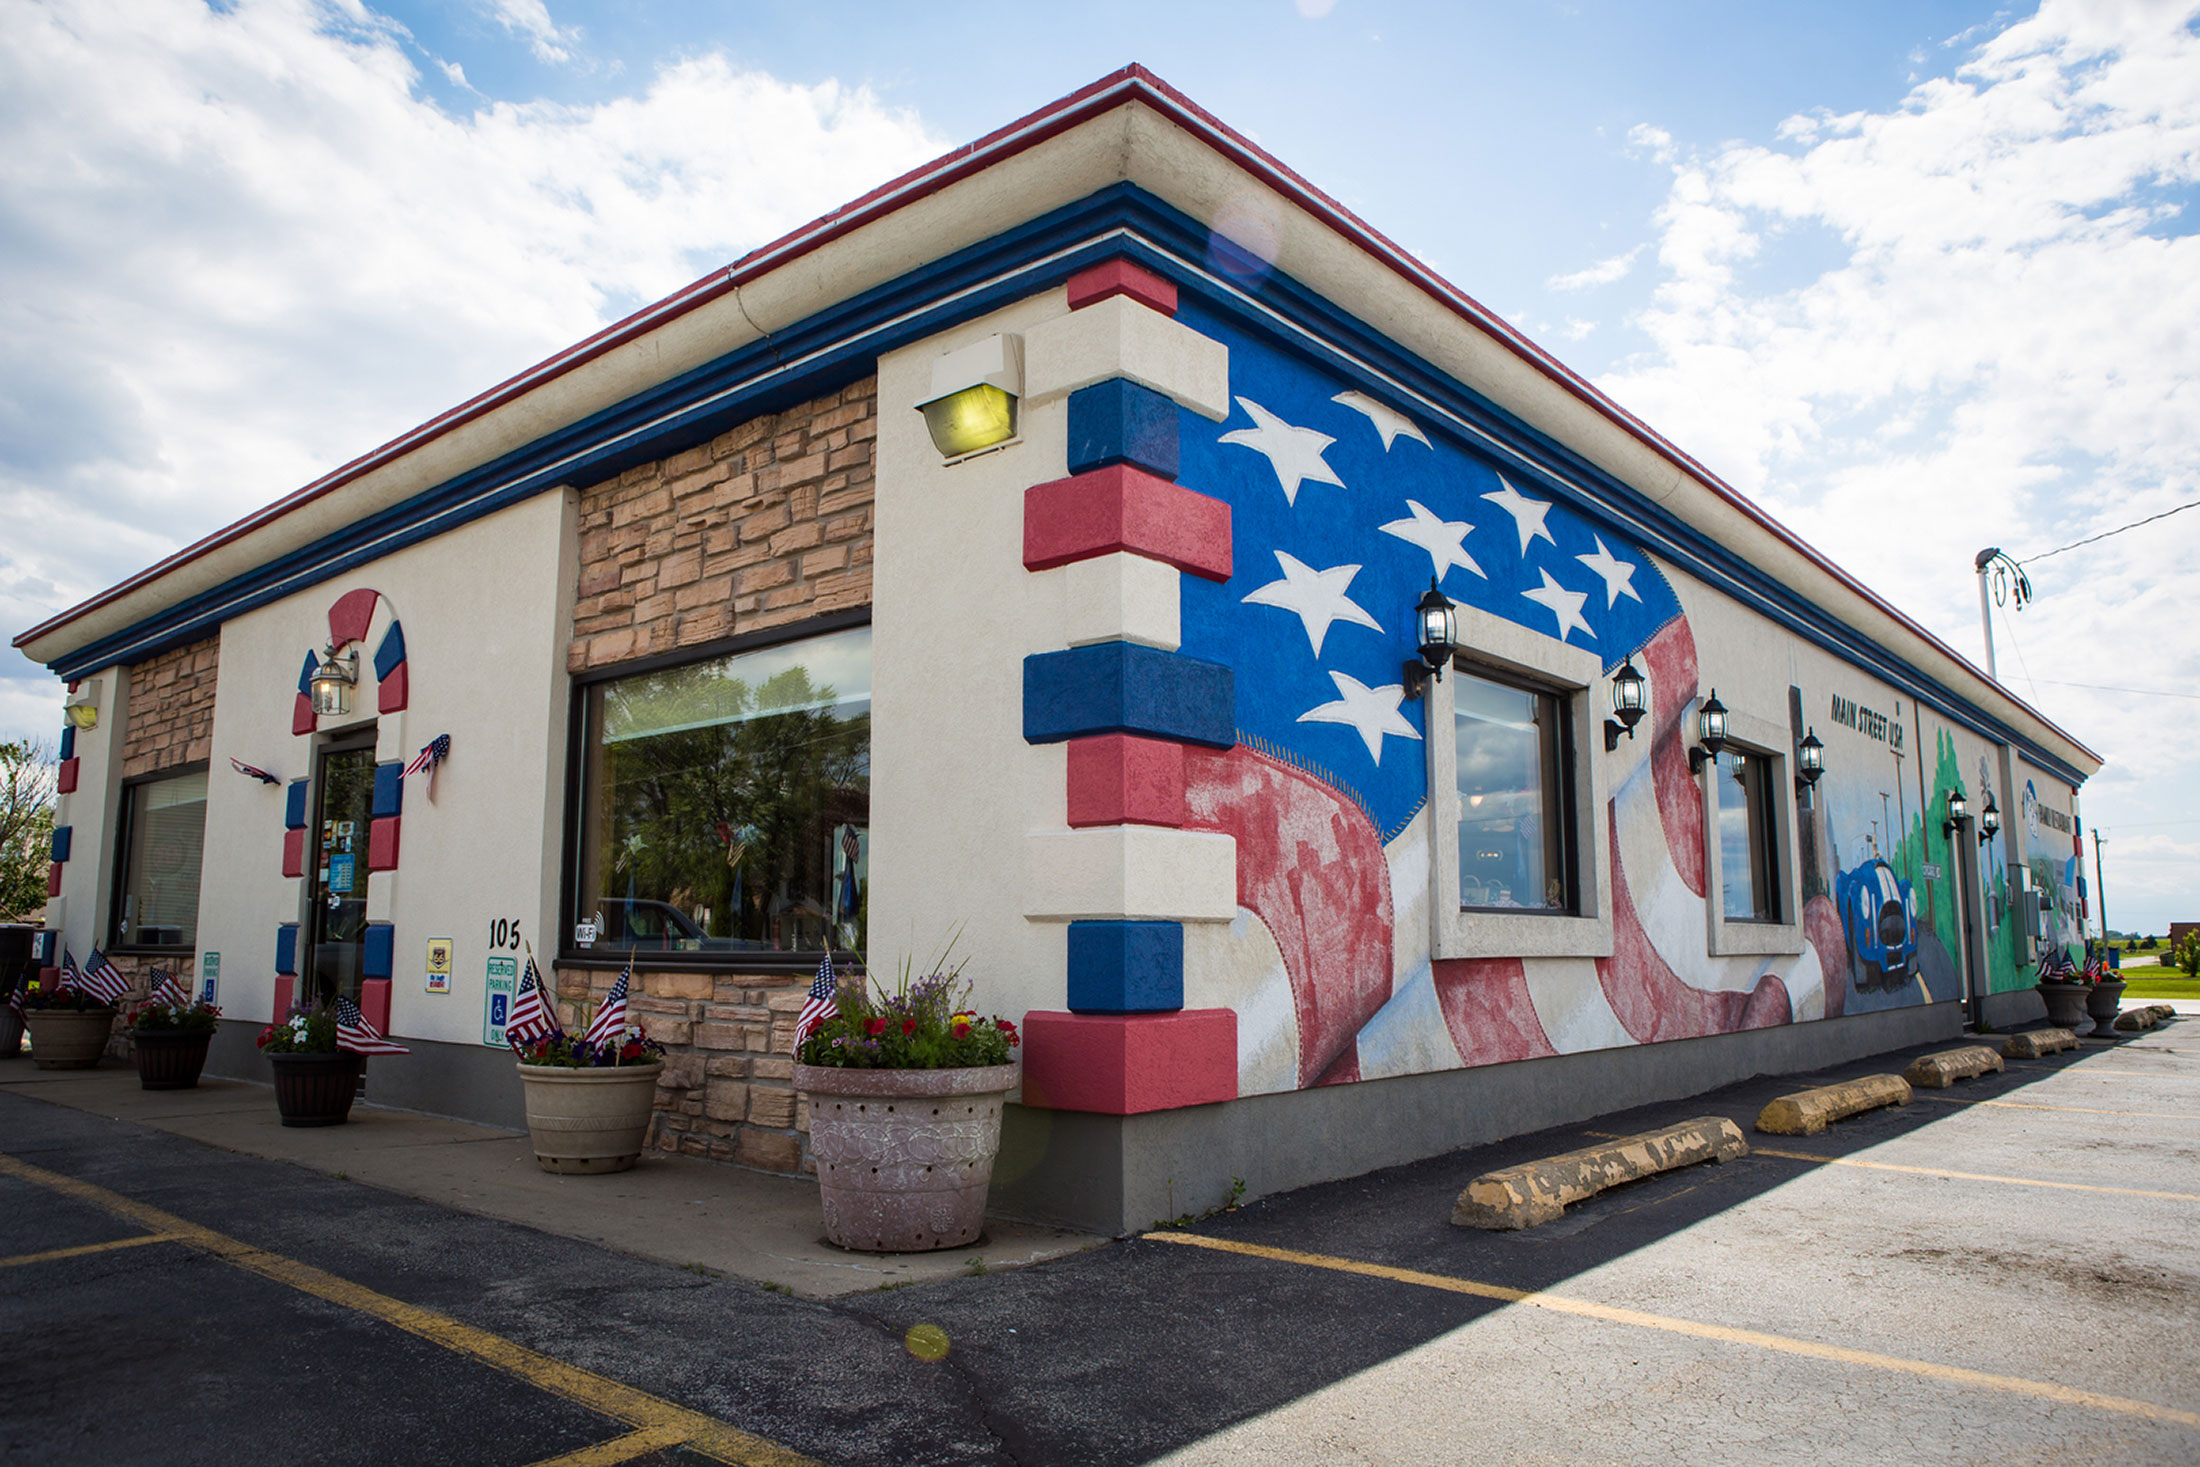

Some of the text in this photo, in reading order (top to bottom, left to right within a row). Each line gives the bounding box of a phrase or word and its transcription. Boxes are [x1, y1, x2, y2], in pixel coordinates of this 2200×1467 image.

[1831, 693, 1904, 751] MAIN STREET USA
[489, 918, 520, 950] 105
[488, 963, 514, 976] RESERVED
[489, 979, 512, 992] PARKING
